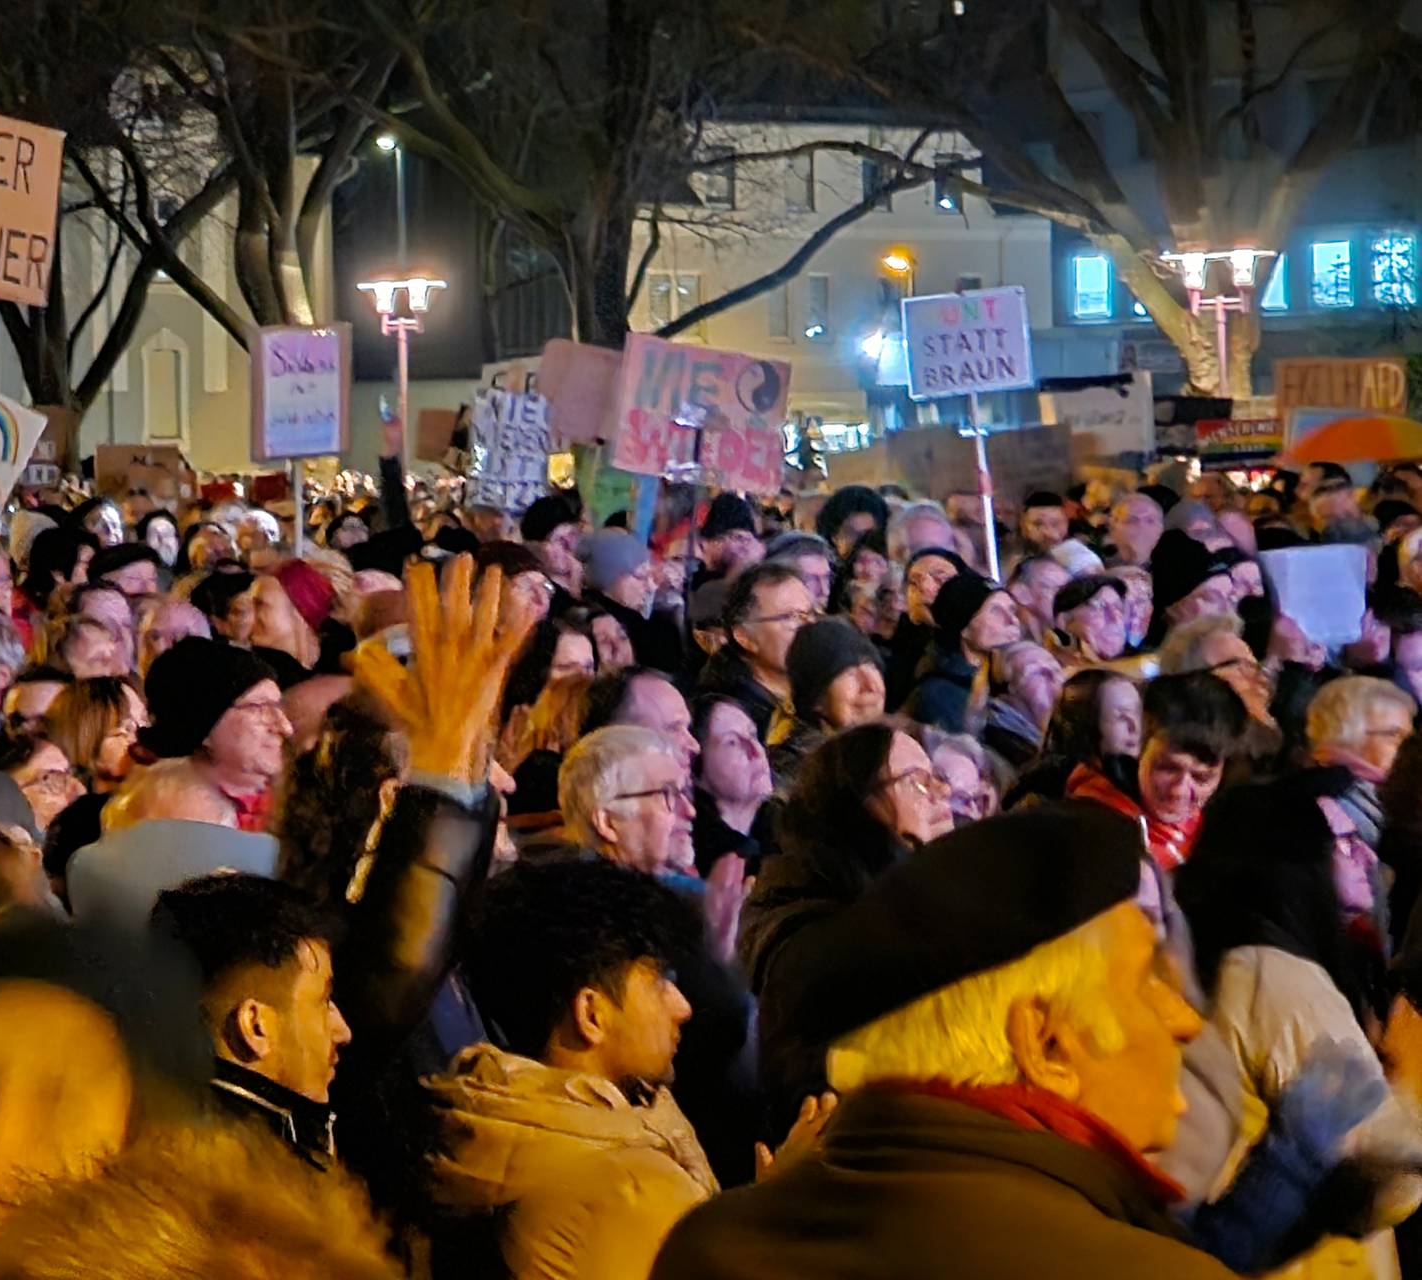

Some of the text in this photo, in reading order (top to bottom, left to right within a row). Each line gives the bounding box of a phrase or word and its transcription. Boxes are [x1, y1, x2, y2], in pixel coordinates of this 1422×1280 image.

[932, 296, 1001, 327] UNT
[922, 328, 1006, 358] STATT
[922, 356, 1016, 387] BRAUN
